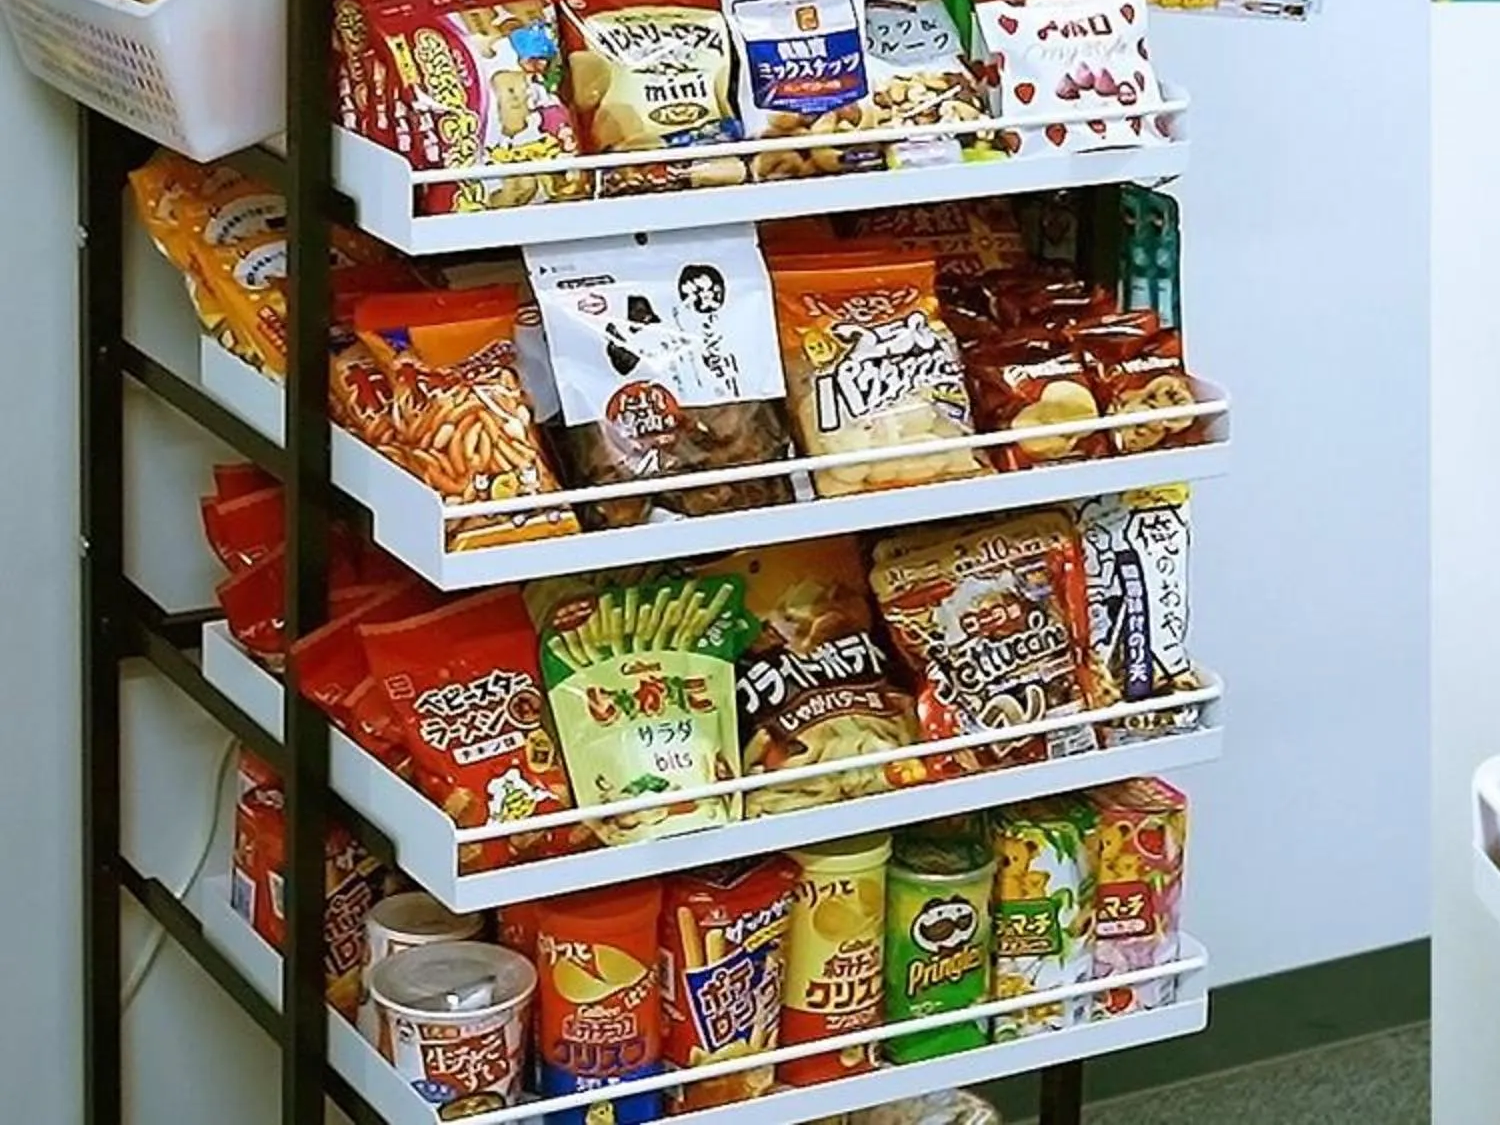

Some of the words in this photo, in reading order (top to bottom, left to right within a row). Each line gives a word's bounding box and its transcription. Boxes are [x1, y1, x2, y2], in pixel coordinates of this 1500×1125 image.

[644, 73, 707, 102] mini
[413, 669, 533, 716] ベビースター
[654, 750, 694, 772] bits
